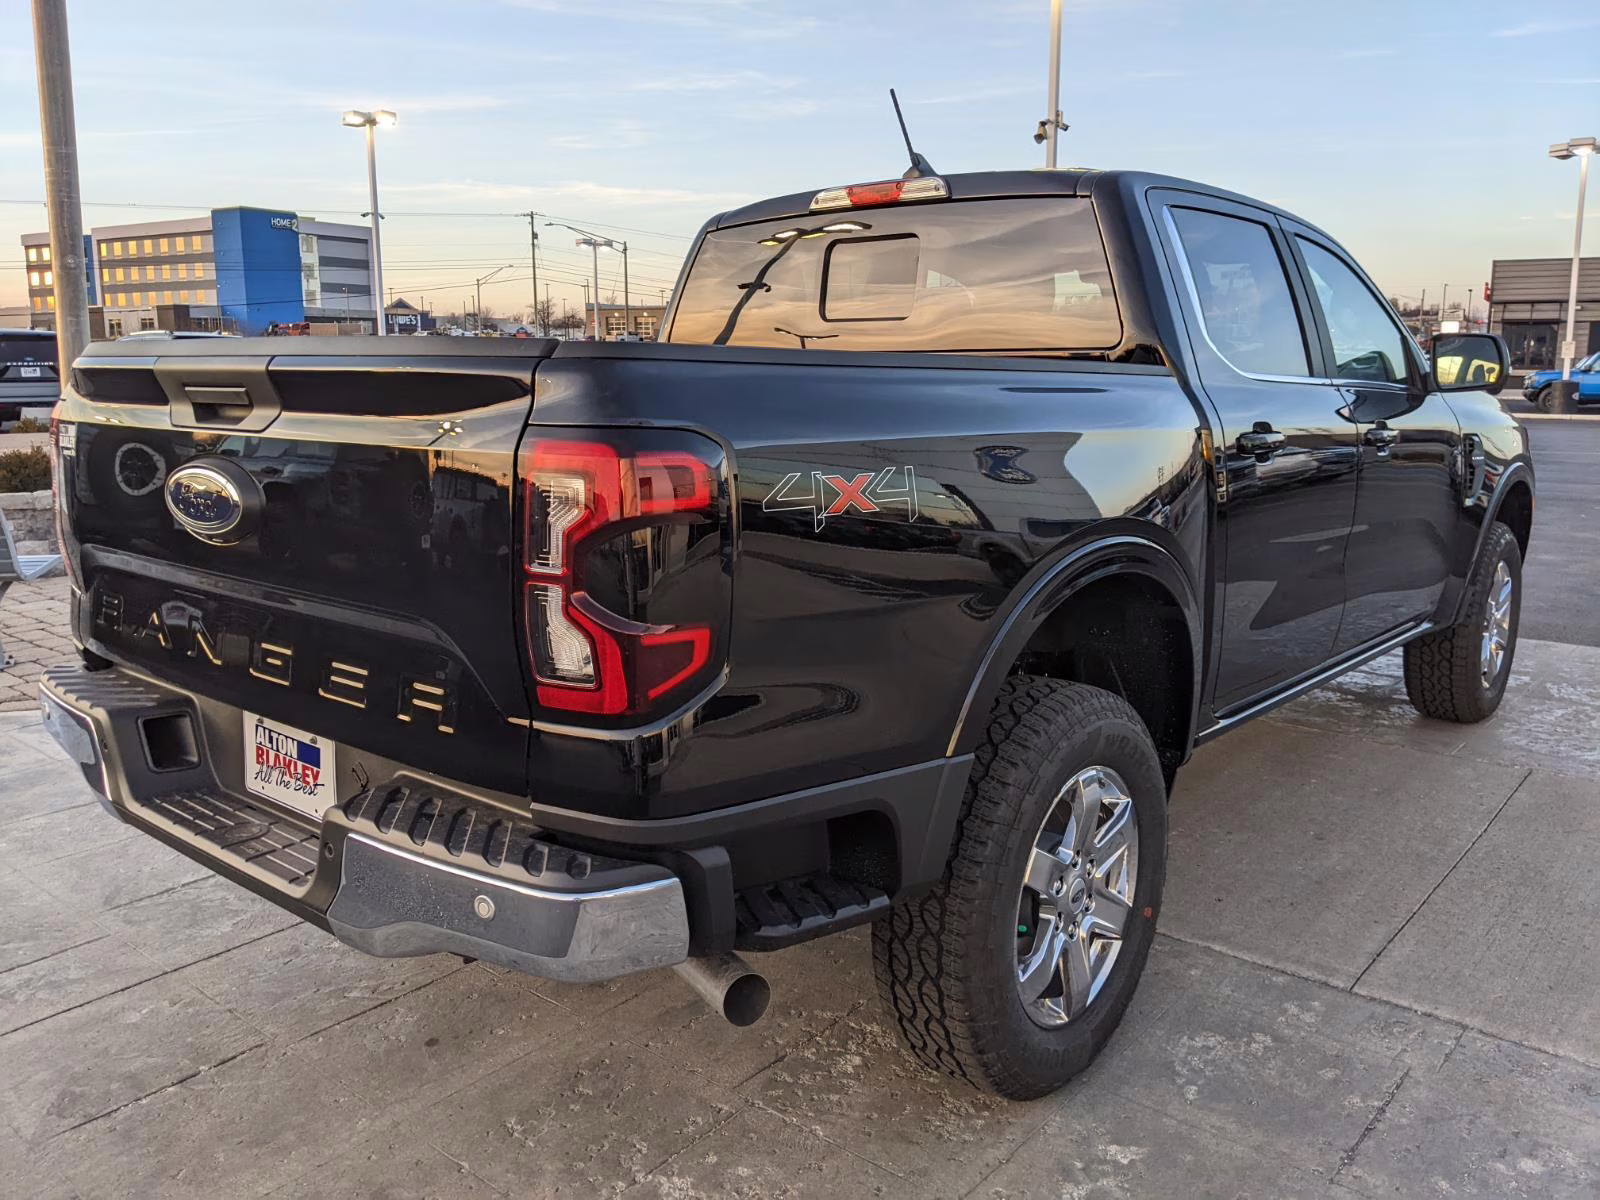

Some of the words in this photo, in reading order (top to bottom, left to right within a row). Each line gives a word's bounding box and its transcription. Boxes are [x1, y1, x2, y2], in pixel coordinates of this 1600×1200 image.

[97, 593, 456, 735] RANGER
[256, 726, 299, 759] ALTON
[254, 763, 273, 785] All
[271, 768, 290, 789] The
[292, 773, 325, 796] Best
[255, 745, 321, 786] BLAKLEY
